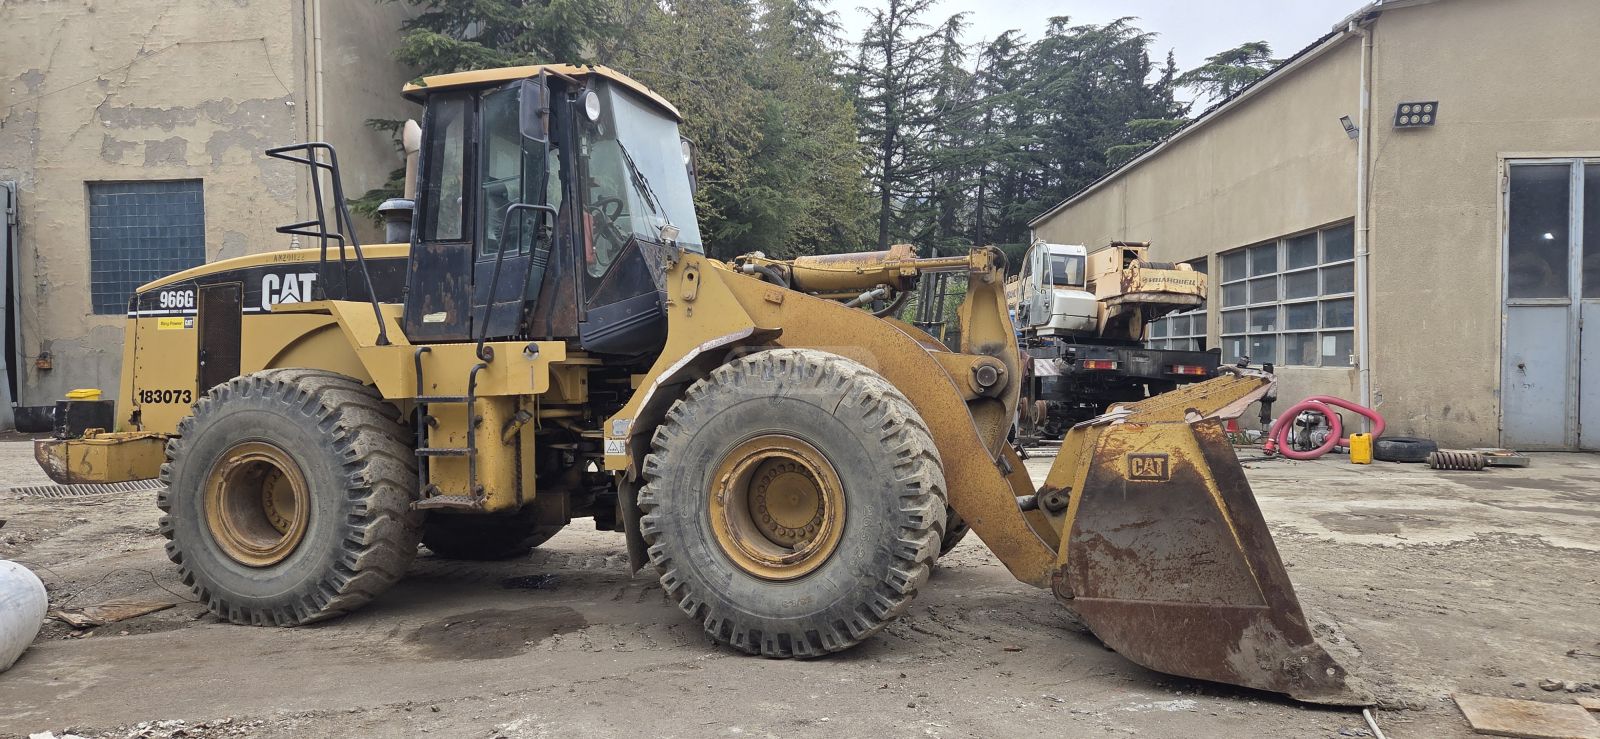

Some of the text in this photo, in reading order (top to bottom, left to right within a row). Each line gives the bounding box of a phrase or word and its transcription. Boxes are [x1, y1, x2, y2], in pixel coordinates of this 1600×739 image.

[160, 290, 194, 308] 966G
[261, 272, 317, 311] CAT
[139, 389, 192, 404] 183073
[1131, 457, 1165, 477] CAT
